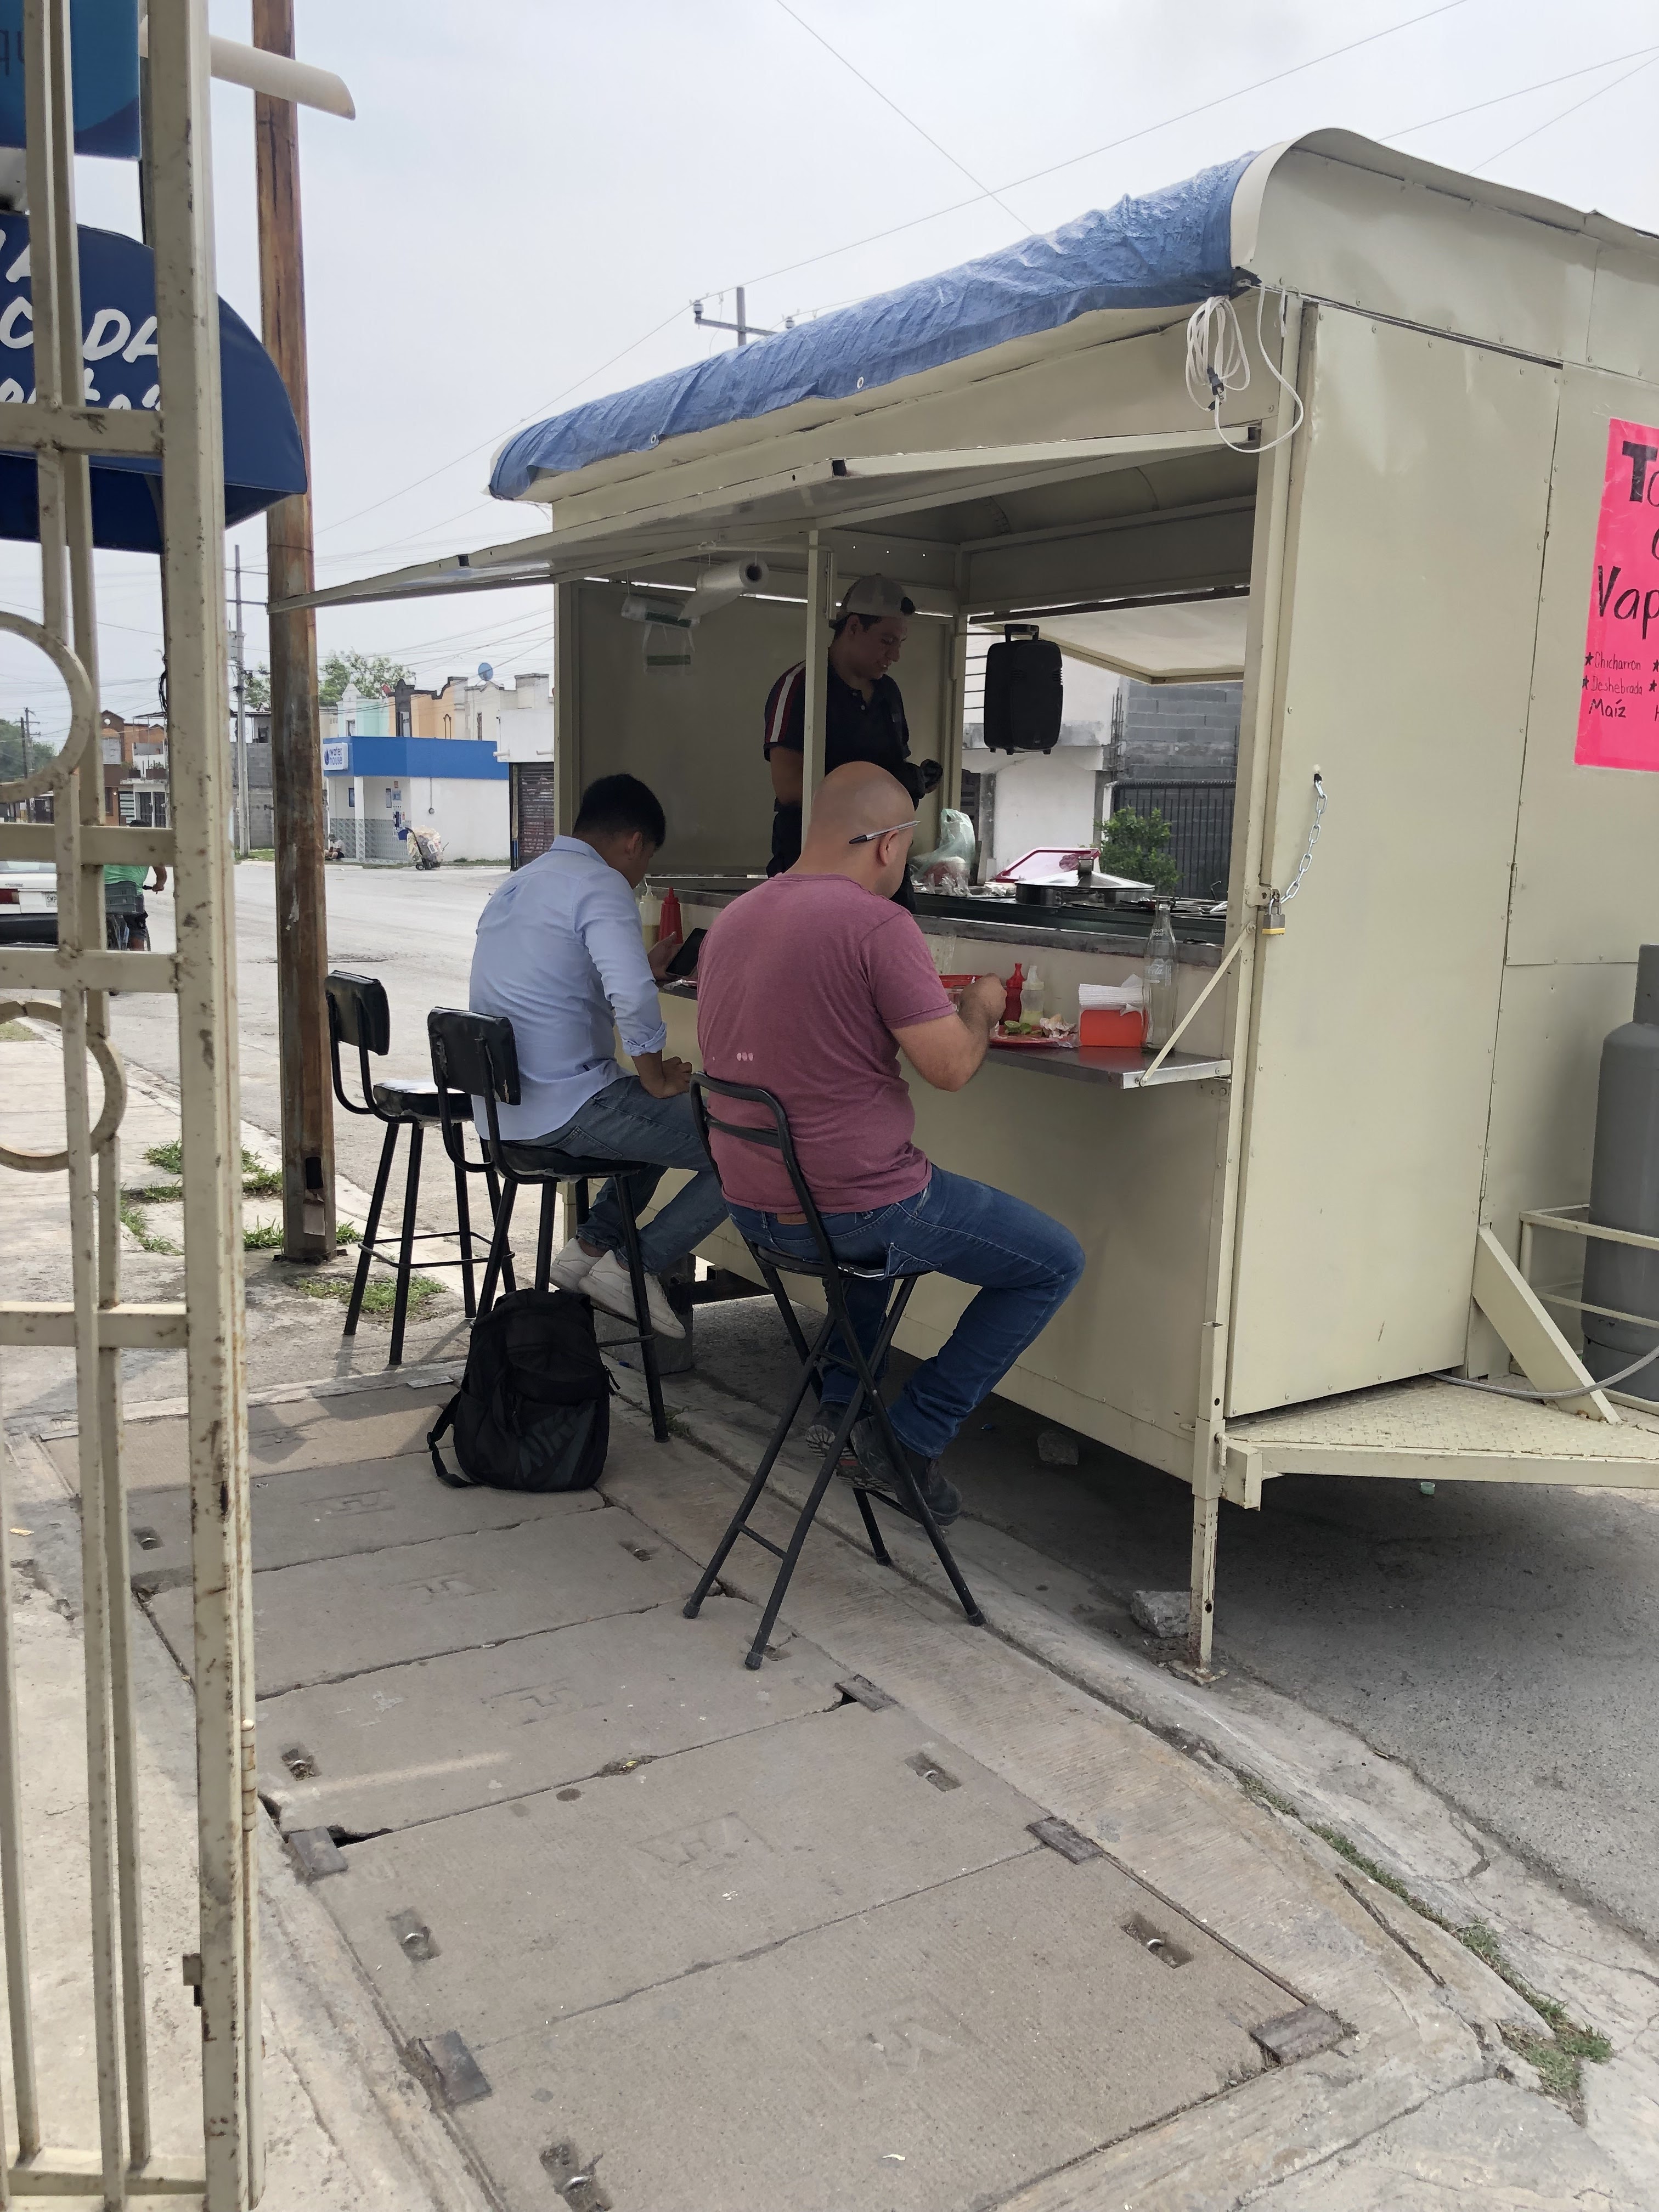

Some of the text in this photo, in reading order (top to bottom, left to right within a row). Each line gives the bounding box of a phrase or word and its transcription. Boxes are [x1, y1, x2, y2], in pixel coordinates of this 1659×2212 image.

[1594, 651, 1641, 670] Chicharron
[1591, 675, 1642, 695] Deshebrada
[1589, 698, 1626, 718] Maíz
